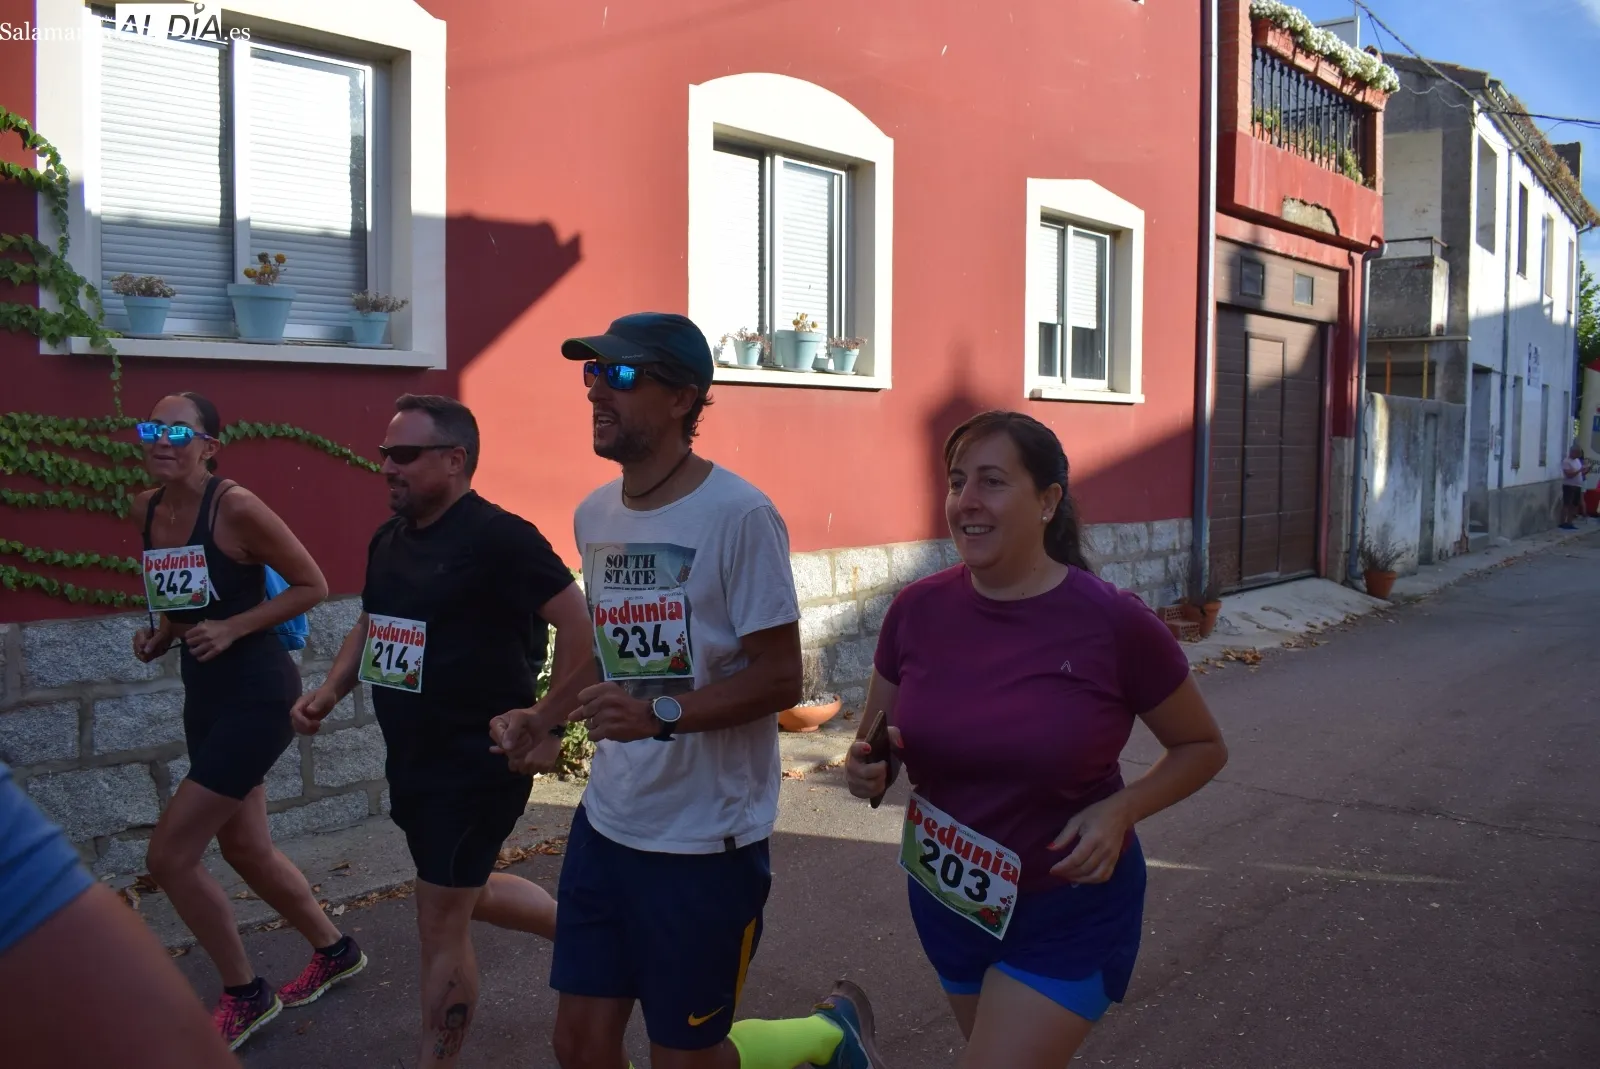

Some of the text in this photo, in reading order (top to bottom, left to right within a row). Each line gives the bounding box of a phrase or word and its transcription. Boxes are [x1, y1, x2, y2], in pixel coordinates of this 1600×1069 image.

[145, 551, 206, 572] bedunia
[605, 554, 656, 569] SOUTH
[155, 570, 193, 597] 242
[603, 569, 656, 585] STATE
[595, 596, 683, 627] bedunia
[368, 620, 425, 647] bedunia
[612, 624, 671, 658] 234
[371, 641, 409, 673] 214
[906, 799, 1019, 885] bedunia
[919, 838, 991, 903] 203
